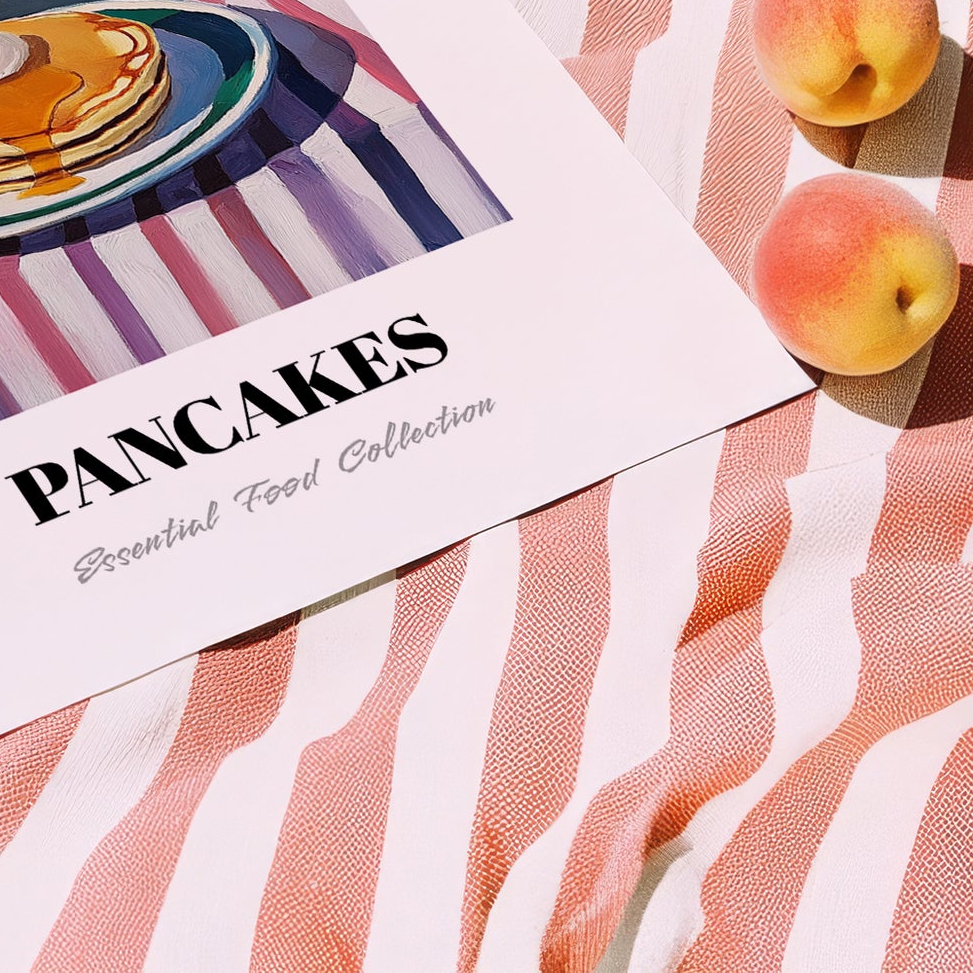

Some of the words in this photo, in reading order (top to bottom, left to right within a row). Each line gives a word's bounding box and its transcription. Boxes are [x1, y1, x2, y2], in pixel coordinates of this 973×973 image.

[4, 313, 449, 526] PANCAKES
[74, 500, 220, 584] Essential
[233, 458, 320, 513] Food
[339, 397, 497, 474] Collection
